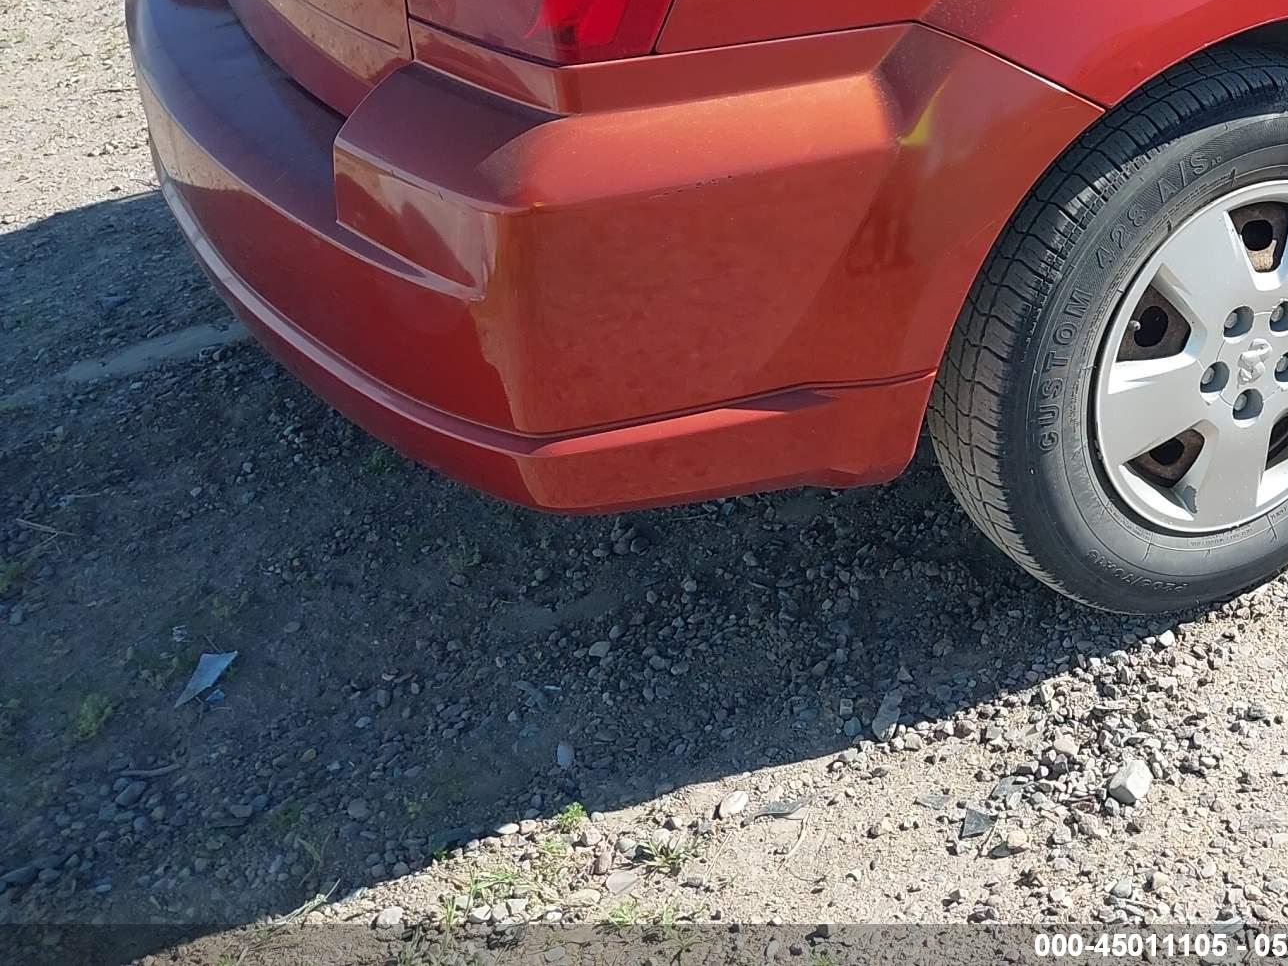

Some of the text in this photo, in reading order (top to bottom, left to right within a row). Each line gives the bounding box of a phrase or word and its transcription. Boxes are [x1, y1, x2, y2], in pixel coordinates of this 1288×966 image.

[1039, 288, 1093, 452] CUSTOM
[1096, 204, 1146, 269] 428
[1157, 152, 1209, 204] A/S
